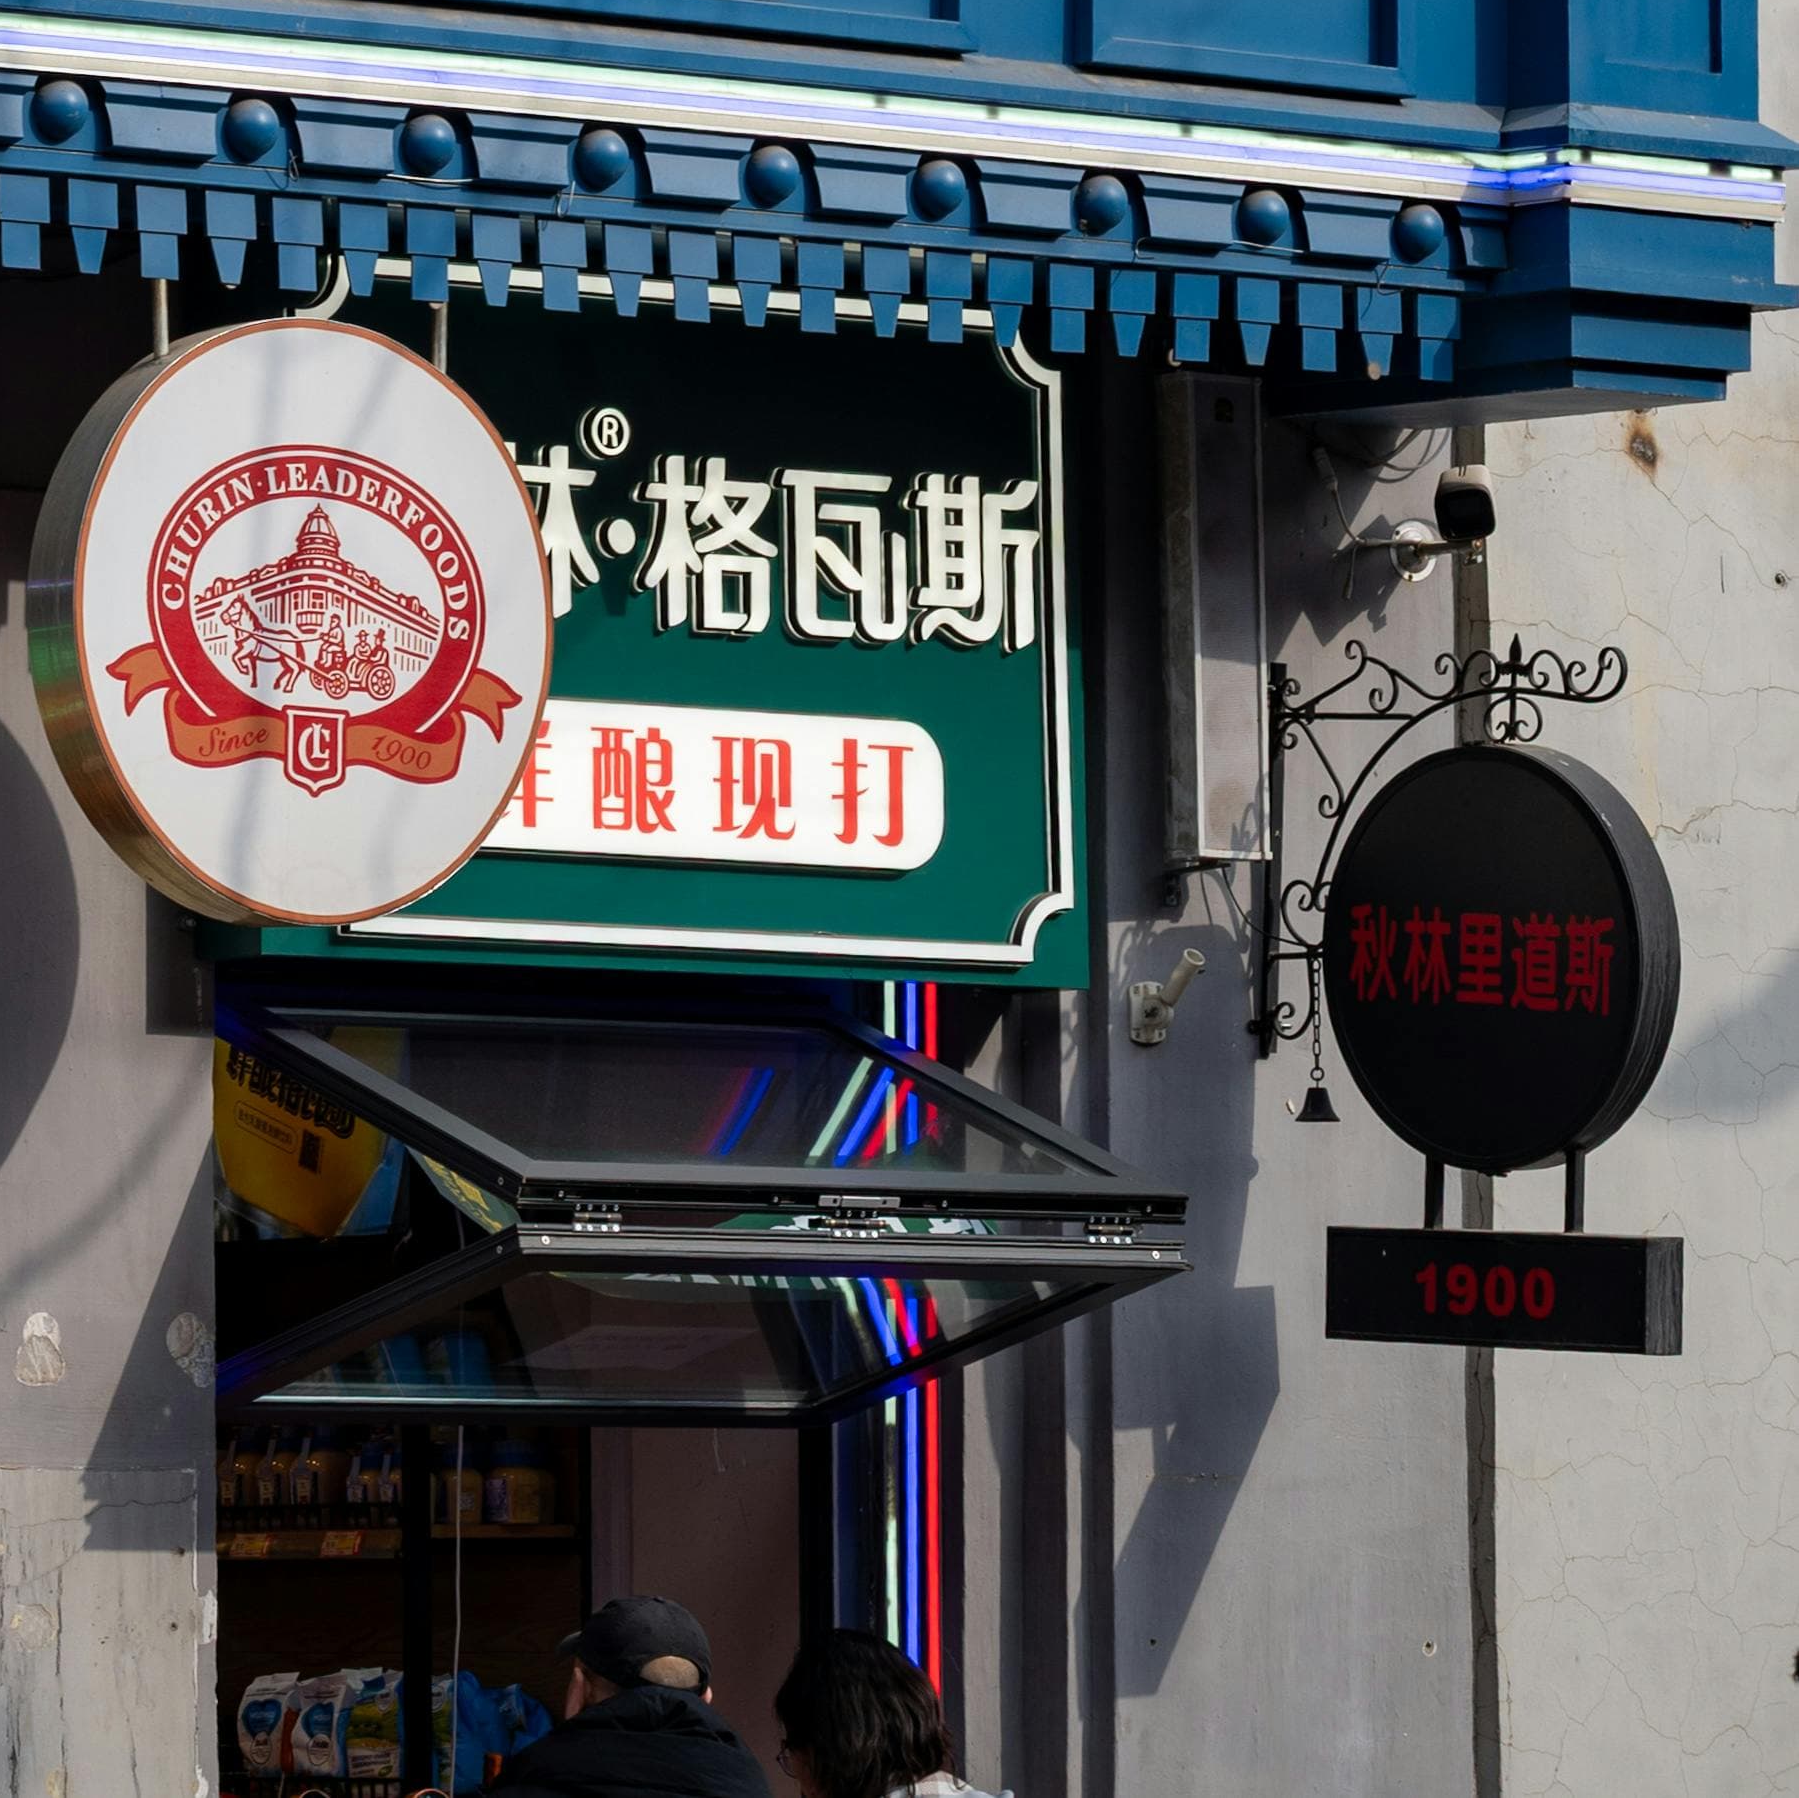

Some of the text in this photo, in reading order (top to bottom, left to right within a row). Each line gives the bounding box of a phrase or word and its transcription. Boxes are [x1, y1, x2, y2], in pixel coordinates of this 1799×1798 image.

[198, 726, 432, 770] Since 1900
[1348, 904, 1615, 1016] 秋林里道斯
[1414, 1260, 1557, 1320] 1900
